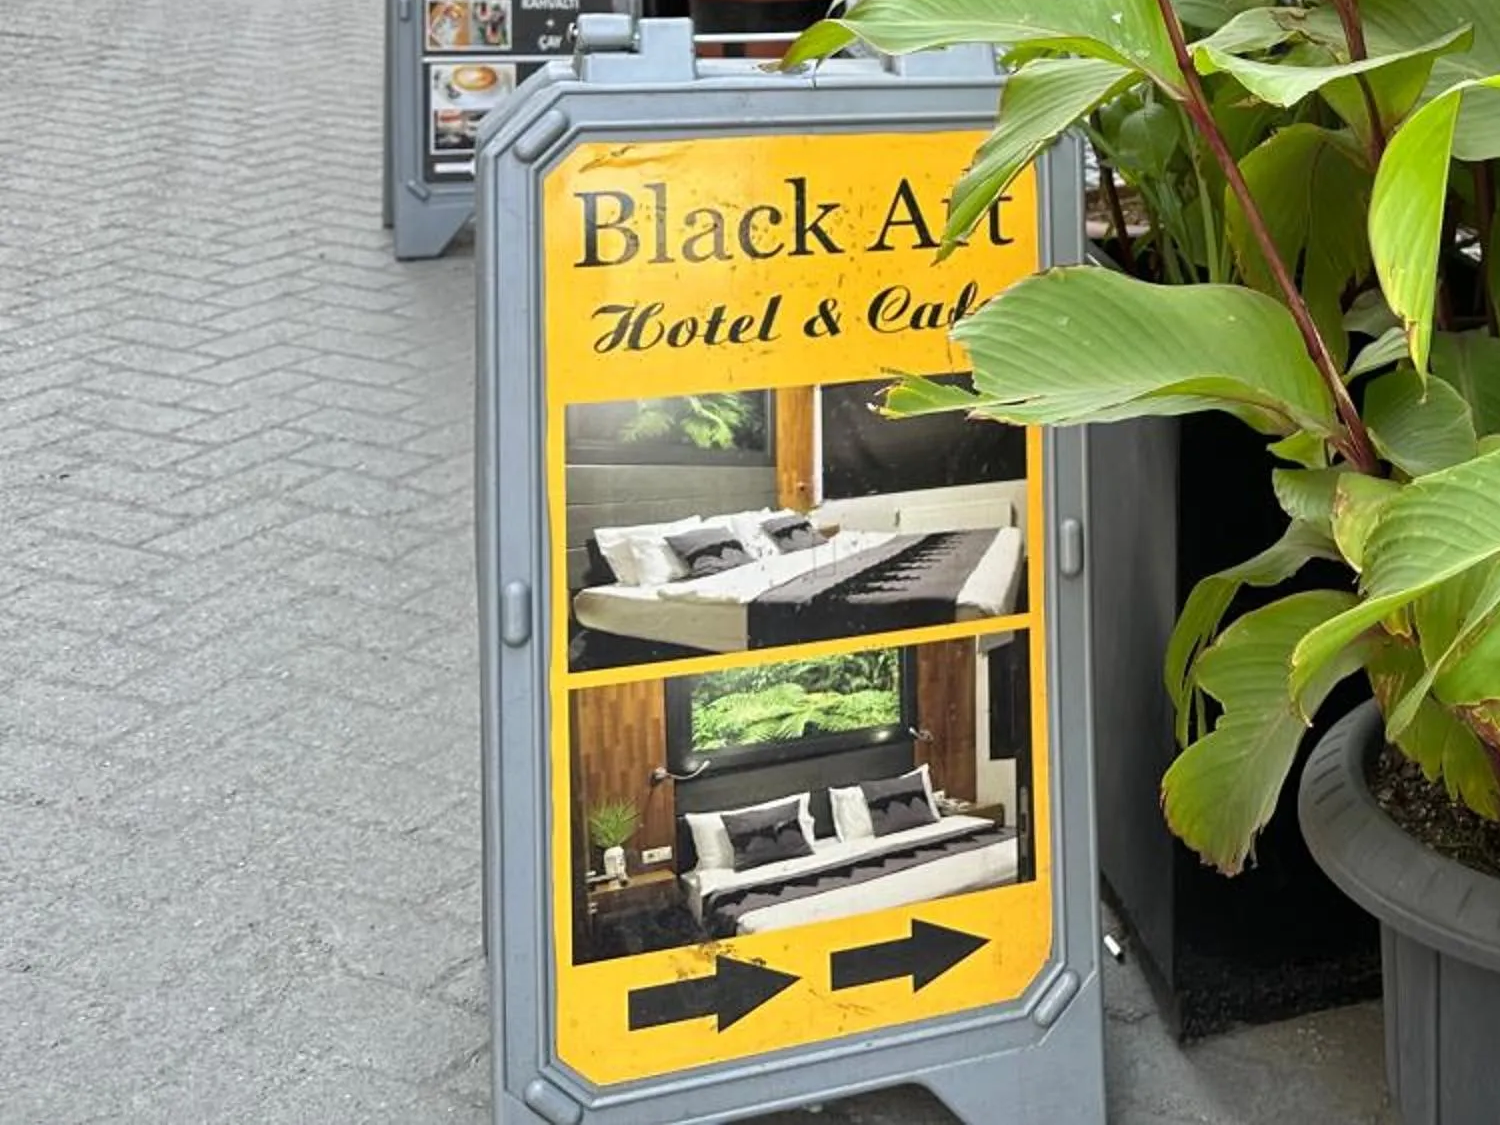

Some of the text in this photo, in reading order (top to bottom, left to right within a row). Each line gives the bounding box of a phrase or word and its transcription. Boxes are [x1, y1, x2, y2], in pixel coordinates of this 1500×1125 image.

[573, 176, 846, 269] Black
[591, 279, 993, 355] Hotel & Caf
